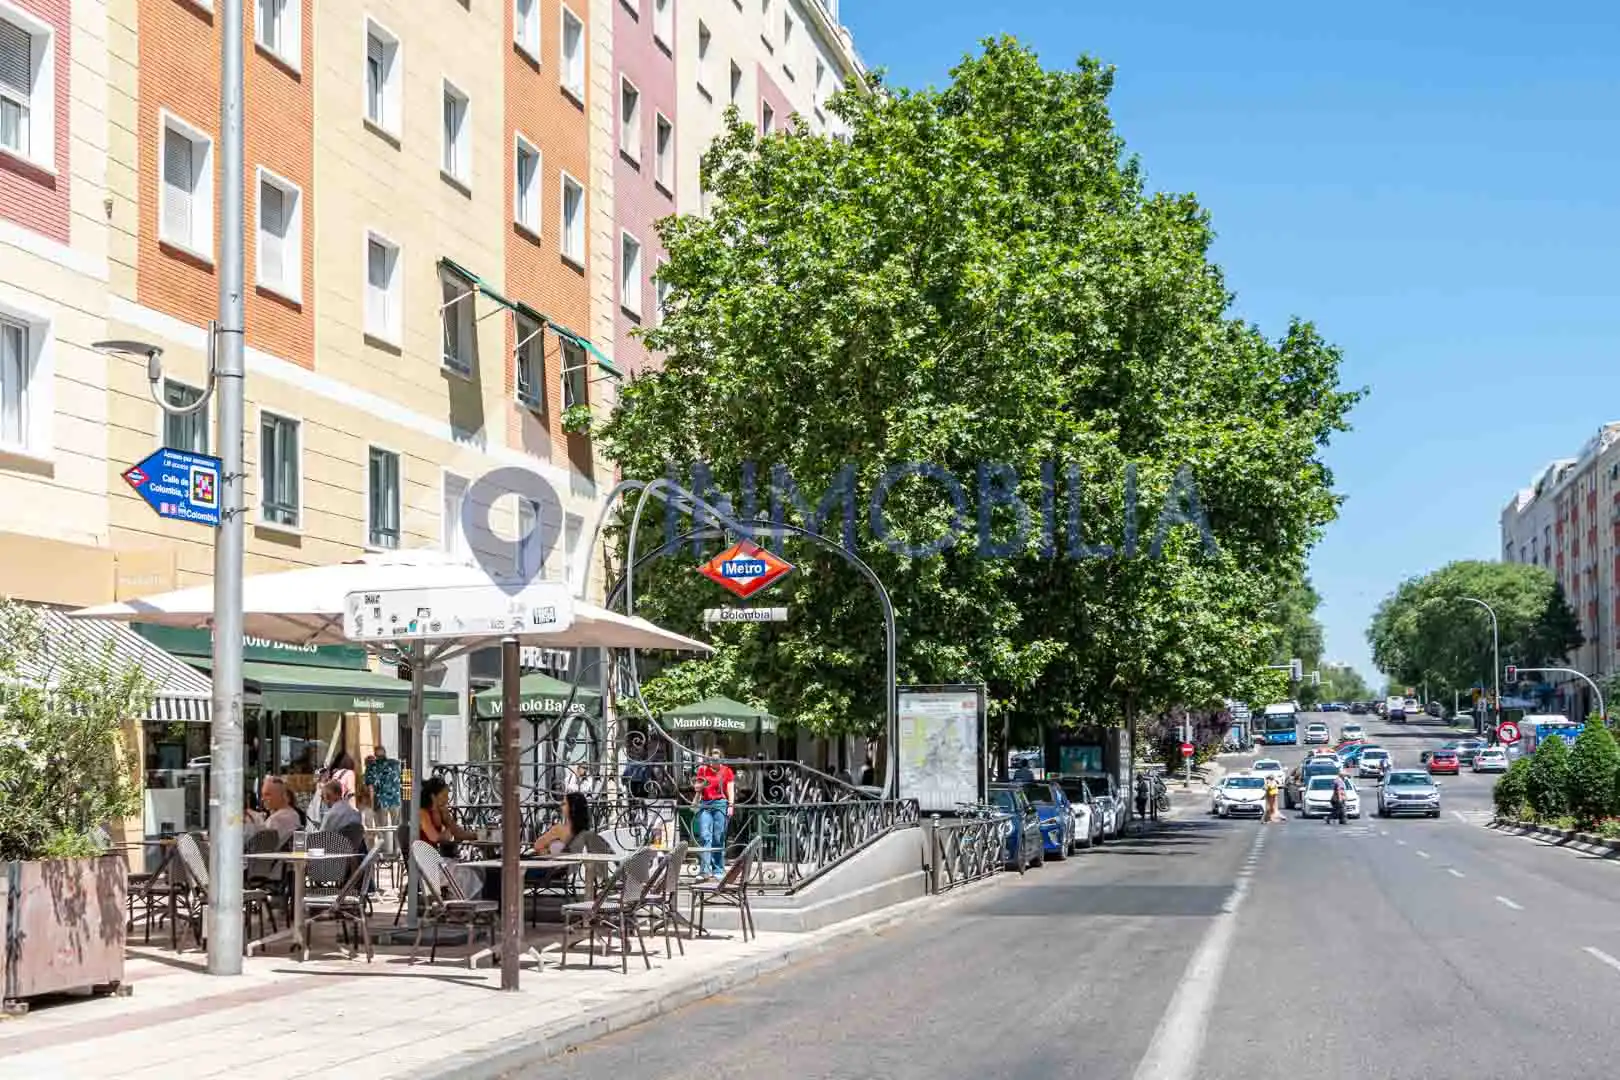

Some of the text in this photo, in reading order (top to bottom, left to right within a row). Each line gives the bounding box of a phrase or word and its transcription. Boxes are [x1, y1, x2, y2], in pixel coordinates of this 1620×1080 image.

[162, 473, 179, 485] Calle
[186, 509, 218, 523] Colombia
[725, 562, 763, 575] Metro
[720, 610, 770, 620] Colombia
[673, 716, 712, 729] Manolo
[713, 717, 746, 730] Bakes
